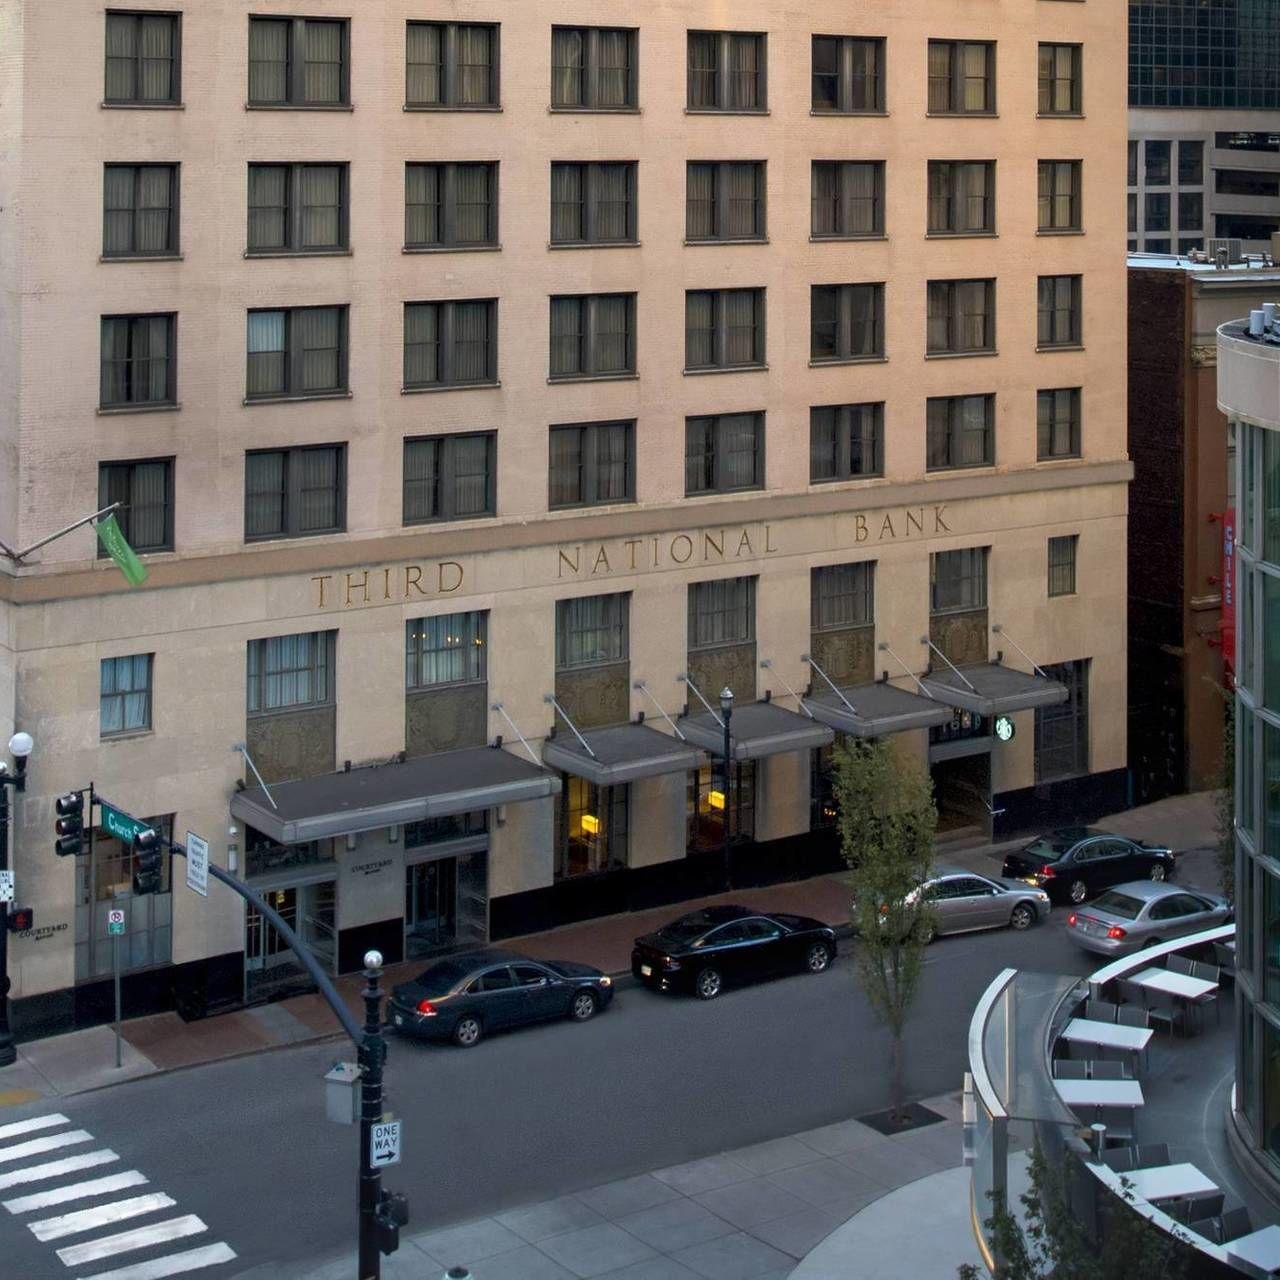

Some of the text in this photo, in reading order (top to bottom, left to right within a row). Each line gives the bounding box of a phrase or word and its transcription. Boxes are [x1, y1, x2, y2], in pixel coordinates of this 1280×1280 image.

[312, 504, 952, 609] THIRD NATIONAL BANK
[108, 813, 133, 839] Church
[376, 1125, 397, 1137] ONE
[375, 1137, 397, 1150] WAY
